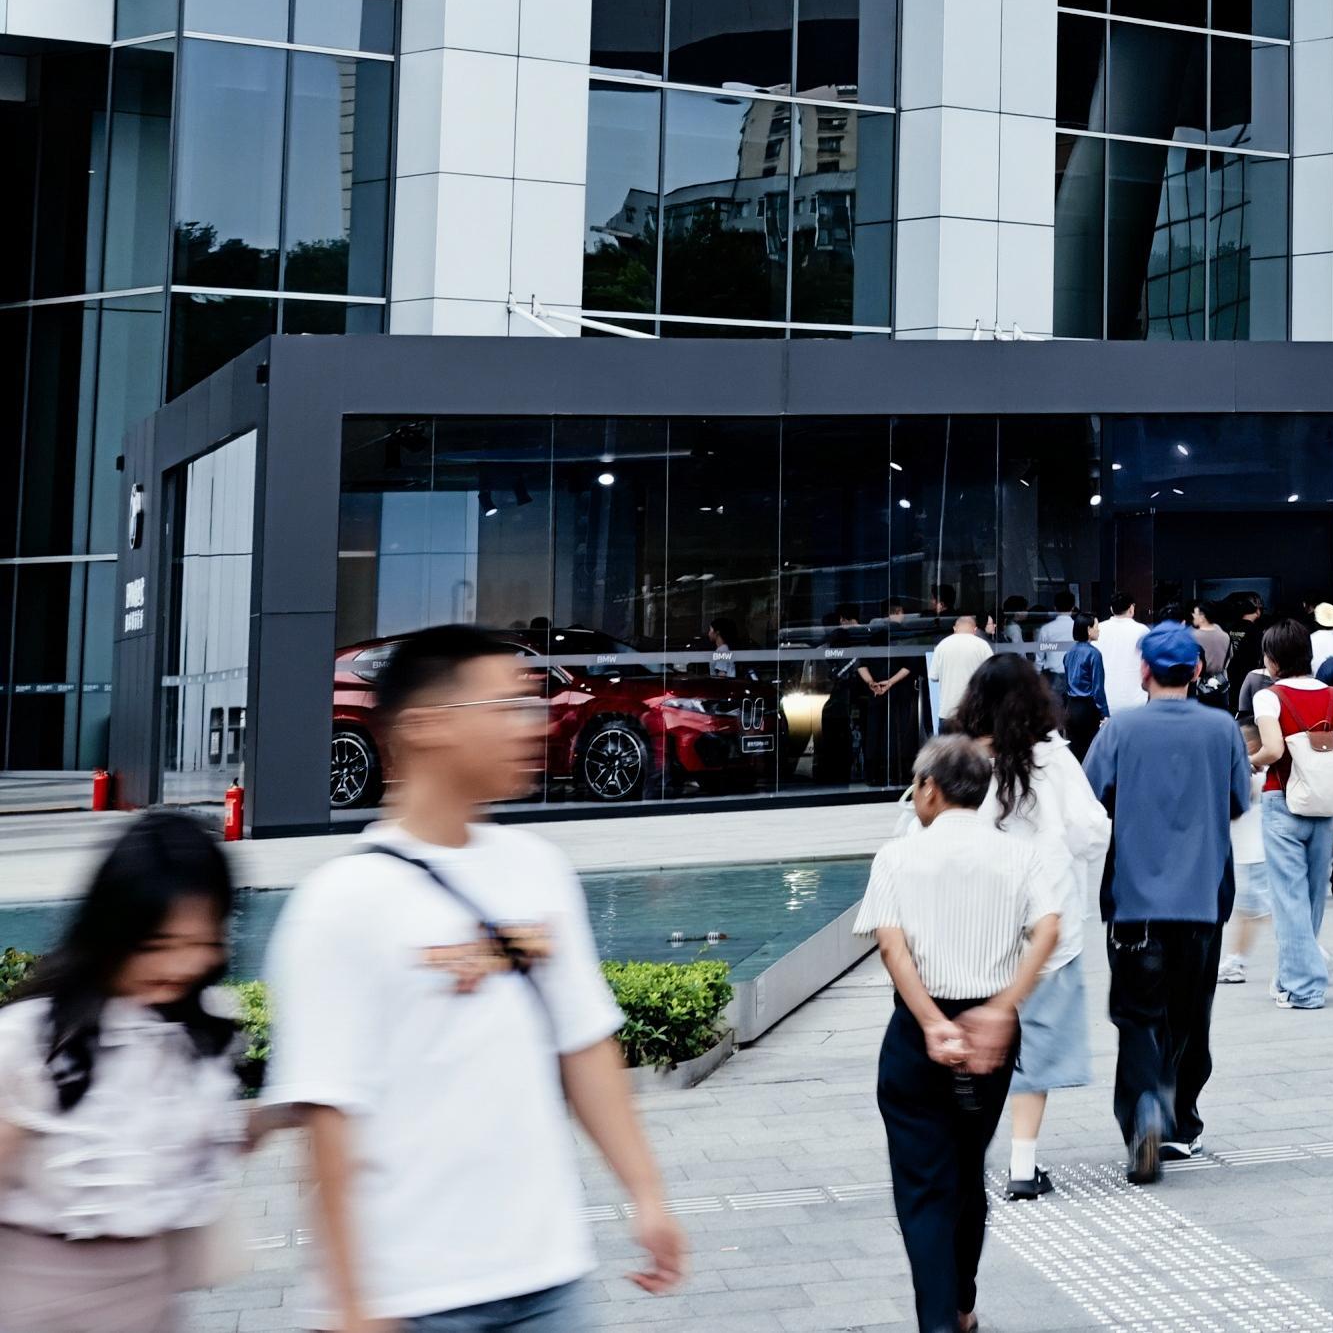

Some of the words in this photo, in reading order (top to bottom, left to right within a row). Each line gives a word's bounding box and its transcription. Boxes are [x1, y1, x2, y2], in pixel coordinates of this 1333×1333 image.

[712, 652, 733, 661] BMW
[824, 649, 845, 658] BMW
[597, 654, 618, 663] BMW
